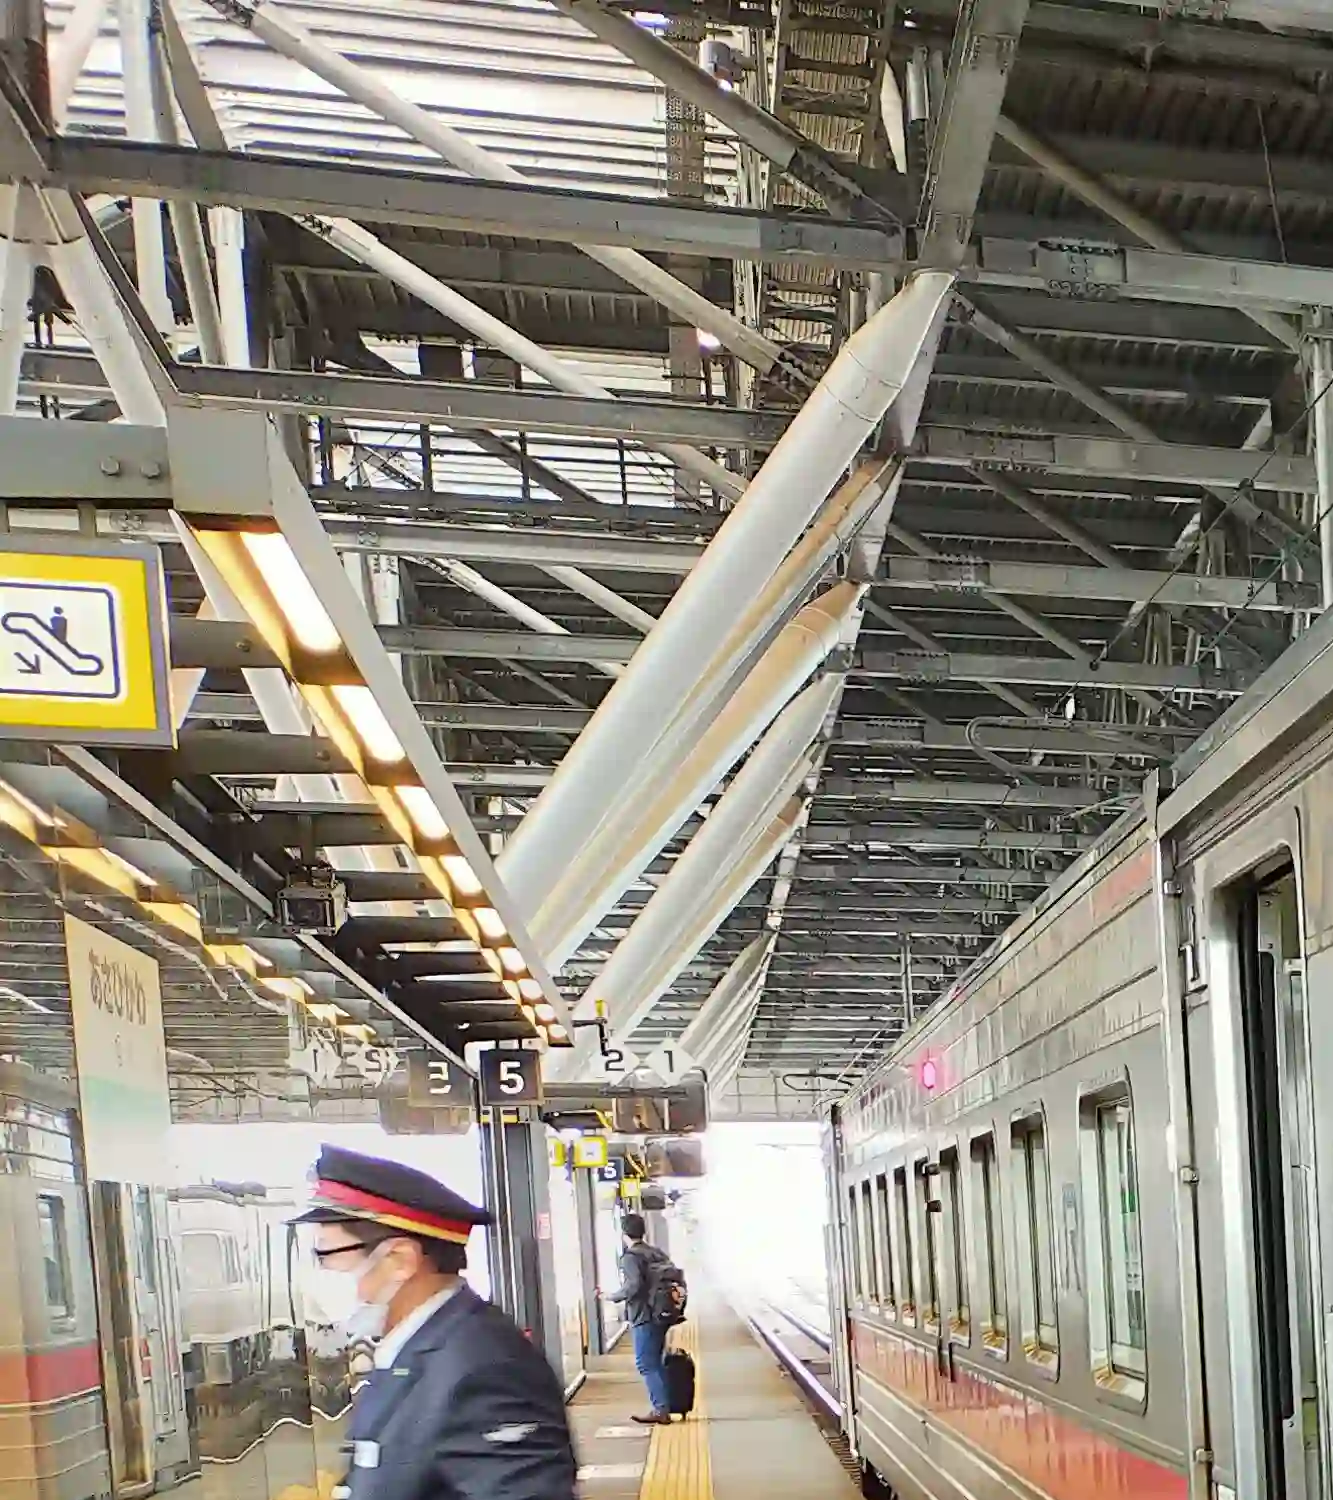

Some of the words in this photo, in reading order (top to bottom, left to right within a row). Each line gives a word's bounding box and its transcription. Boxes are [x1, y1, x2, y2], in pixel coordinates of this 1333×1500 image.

[604, 1049, 625, 1072] 2
[663, 1050, 674, 1073] 1
[499, 1061, 525, 1094] 5
[603, 1160, 617, 1180] 5
